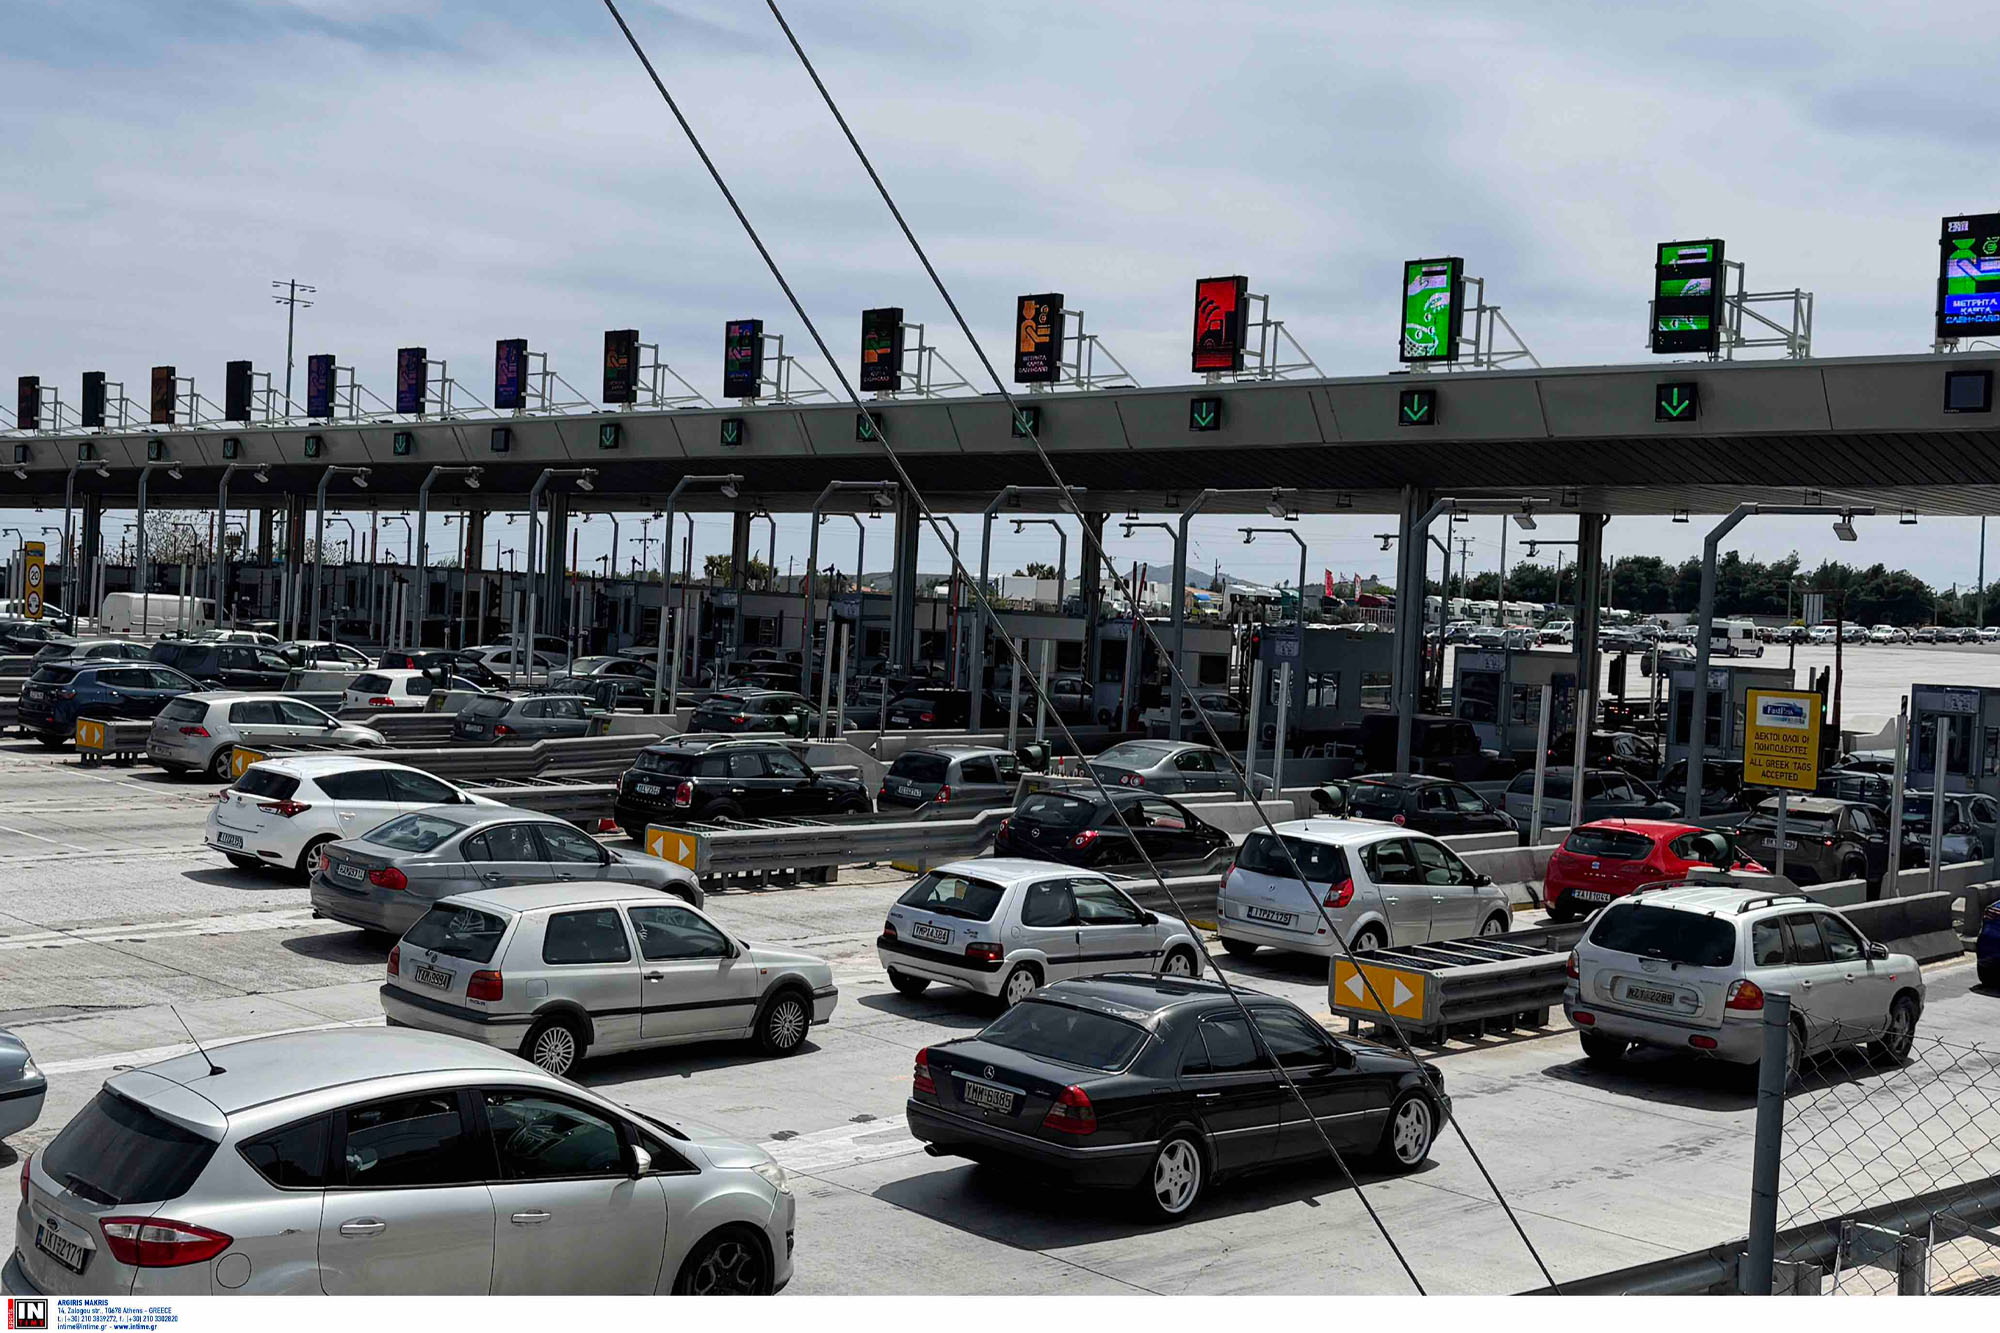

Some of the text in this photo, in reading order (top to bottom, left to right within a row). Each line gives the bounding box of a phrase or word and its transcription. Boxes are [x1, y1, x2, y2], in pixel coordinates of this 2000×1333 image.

[31, 571, 39, 580] 20
[1754, 732, 1780, 741] ΔΕΚΤΟΙ
[1750, 758, 1812, 771] ALL GREEK TAGS
[1761, 770, 1799, 781] ACCEPTED
